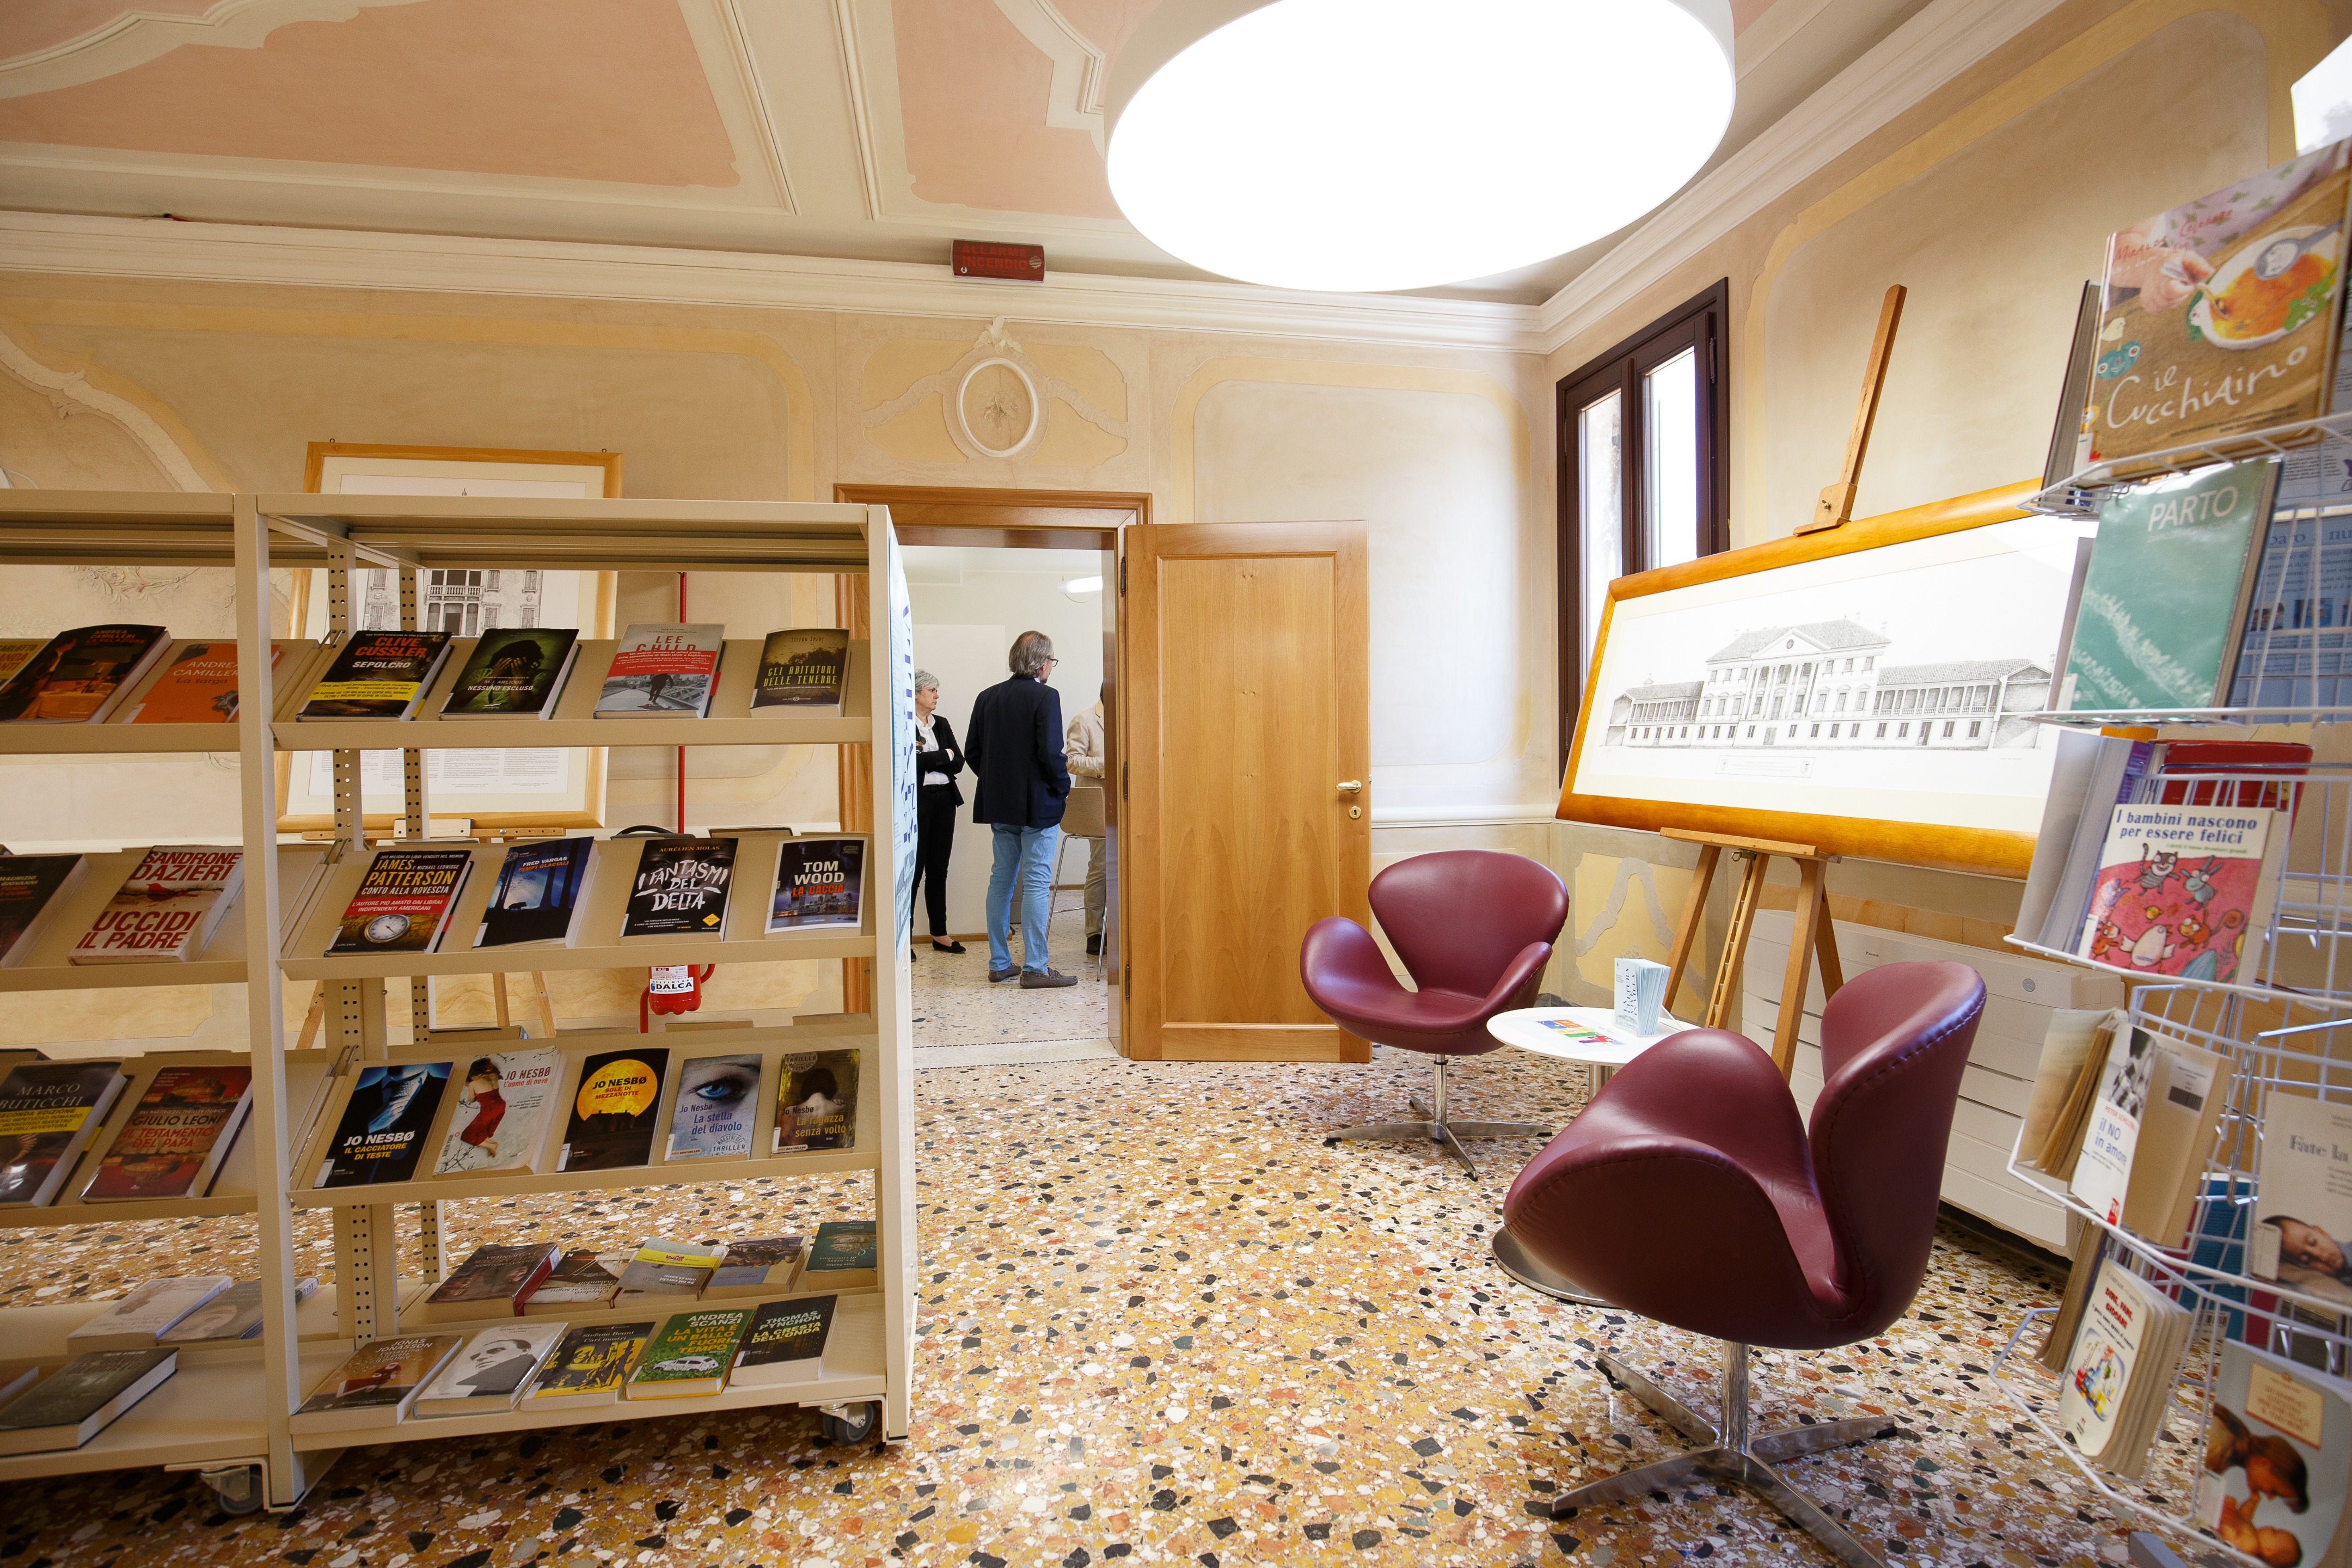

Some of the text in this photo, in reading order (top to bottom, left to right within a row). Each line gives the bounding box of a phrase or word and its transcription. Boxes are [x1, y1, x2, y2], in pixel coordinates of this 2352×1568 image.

[961, 244, 1028, 258] ALLARME
[962, 256, 1028, 270] INCENDIO
[2154, 365, 2177, 391] il
[2147, 486, 2239, 532] PARTO
[375, 638, 422, 646] CLIVE
[355, 647, 427, 657] CUSSLER
[768, 666, 836, 676] GLI ABITATORI
[763, 675, 837, 687] DELLE TENEBRE
[2127, 811, 2183, 826] bambini
[2187, 814, 2258, 831] nascono
[2120, 826, 2243, 845] per essere felici
[143, 852, 243, 865] SANDRONE
[374, 859, 414, 870] JAMES
[540, 861, 569, 869] GLACIALI
[130, 864, 234, 881] DAZIERI
[803, 861, 838, 873] TOM
[365, 871, 457, 886] PATTERSON
[639, 860, 728, 890] I FANTASMI
[794, 872, 844, 885] WOOD
[362, 887, 388, 895] CONTO
[412, 886, 450, 895] ROVESCIA
[666, 878, 700, 891] DEL
[792, 884, 844, 897] LA CACCIA
[651, 891, 706, 911] DELTA
[91, 910, 203, 932] UCCIDI
[75, 931, 188, 949] IL PADRE
[505, 1067, 552, 1081] JO NESBØ
[592, 1076, 647, 1089] JO NESBØ
[17, 1083, 81, 1096] MARCO
[595, 1091, 640, 1100] MEZZANOTTE
[0, 1096, 84, 1110] BUTICCHI
[679, 1104, 713, 1113] Jo Nesbø
[132, 1113, 223, 1126] GIULIO LEONI
[694, 1111, 732, 1124] La stella
[797, 1114, 844, 1126] La ragazza
[138, 1126, 215, 1138] TESTAMENTO
[691, 1122, 742, 1135] del diavolo
[795, 1125, 846, 1137] senza volto
[2107, 1123, 2121, 1141] NO
[131, 1137, 194, 1148] DEL PAPA
[344, 1130, 415, 1147] JO NESBØ
[717, 1135, 736, 1144] MAESTRI
[354, 1143, 408, 1153] CACCIATORE
[2094, 1132, 2105, 1148] in
[2105, 1142, 2127, 1166] amore
[2331, 1142, 2349, 1163] la
[688, 1313, 744, 1322] ANDREA
[689, 1318, 742, 1327] SCANZI
[759, 1315, 821, 1330] PYNCHON
[766, 1311, 818, 1325] THOMAS
[696, 1326, 726, 1334] VITA
[773, 1321, 821, 1336] CRESTA
[391, 1338, 426, 1346] JONAS
[688, 1338, 731, 1346] FUORI
[689, 1331, 734, 1340] BALLO
[751, 1327, 820, 1344] DELL'ONDA
[376, 1343, 433, 1353] JONASSON
[679, 1344, 728, 1354] TEMPO
